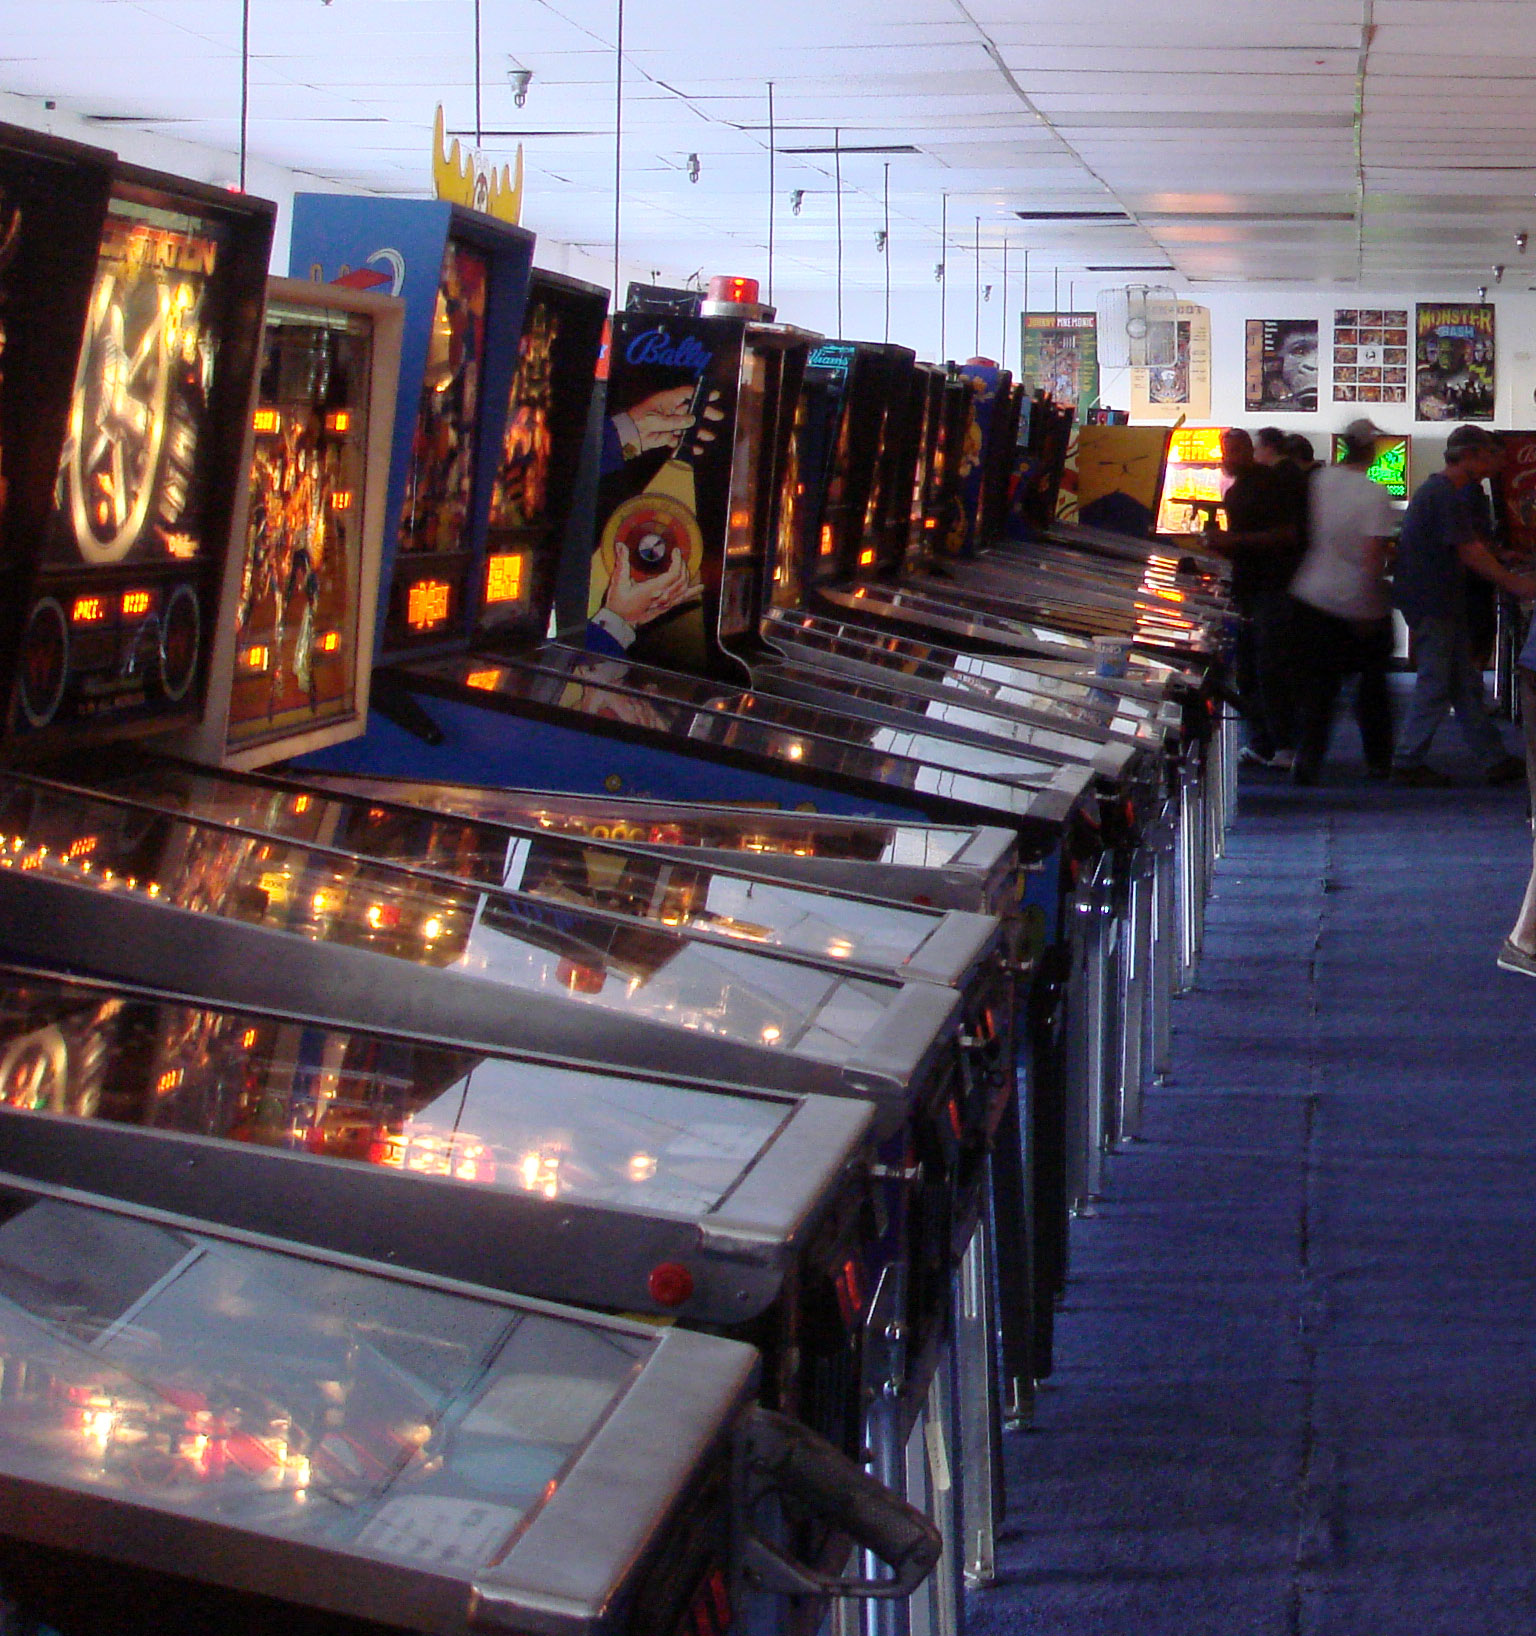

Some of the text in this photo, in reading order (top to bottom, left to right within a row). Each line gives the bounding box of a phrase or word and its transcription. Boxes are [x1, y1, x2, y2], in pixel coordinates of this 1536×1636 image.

[1057, 316, 1094, 328] MNEMONIC
[1418, 308, 1492, 336] MONSTER
[1437, 325, 1476, 339] BASH
[626, 329, 713, 379] Bally
